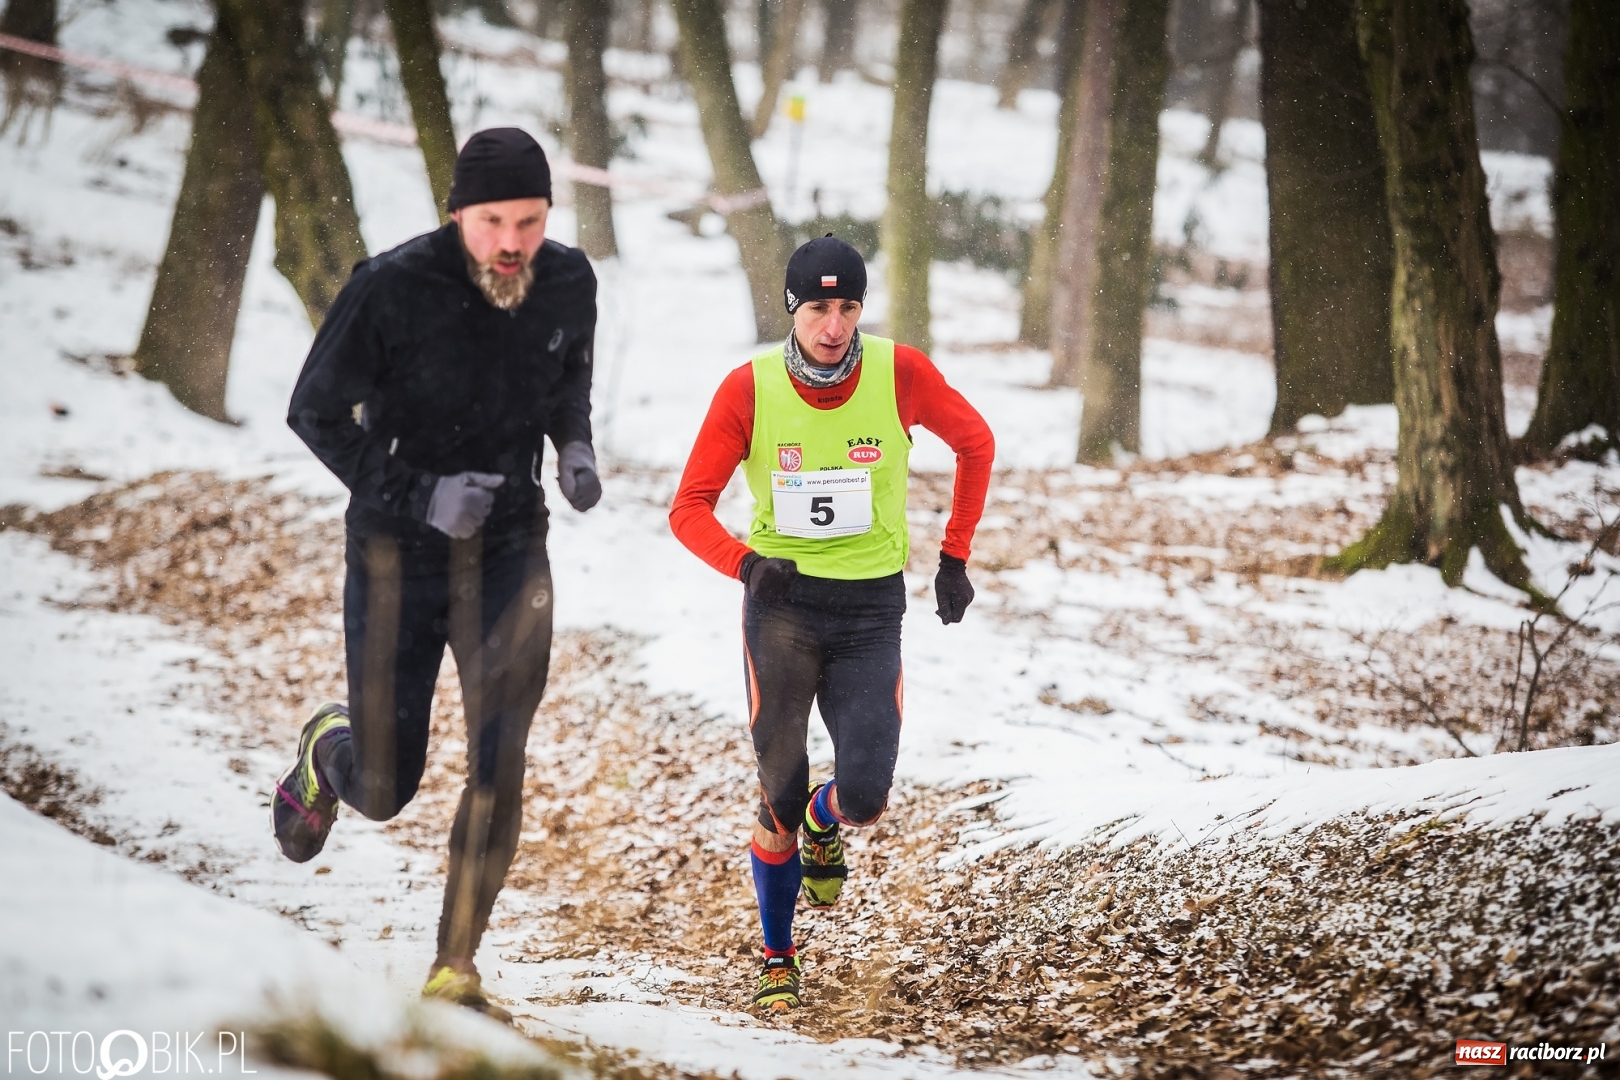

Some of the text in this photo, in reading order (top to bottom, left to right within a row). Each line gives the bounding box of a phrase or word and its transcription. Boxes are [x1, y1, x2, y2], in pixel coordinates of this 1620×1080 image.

[817, 395, 843, 403] kipsta
[847, 437, 882, 447] EASY
[807, 477, 867, 485] www.personalbest.pl
[810, 496, 835, 526] 5
